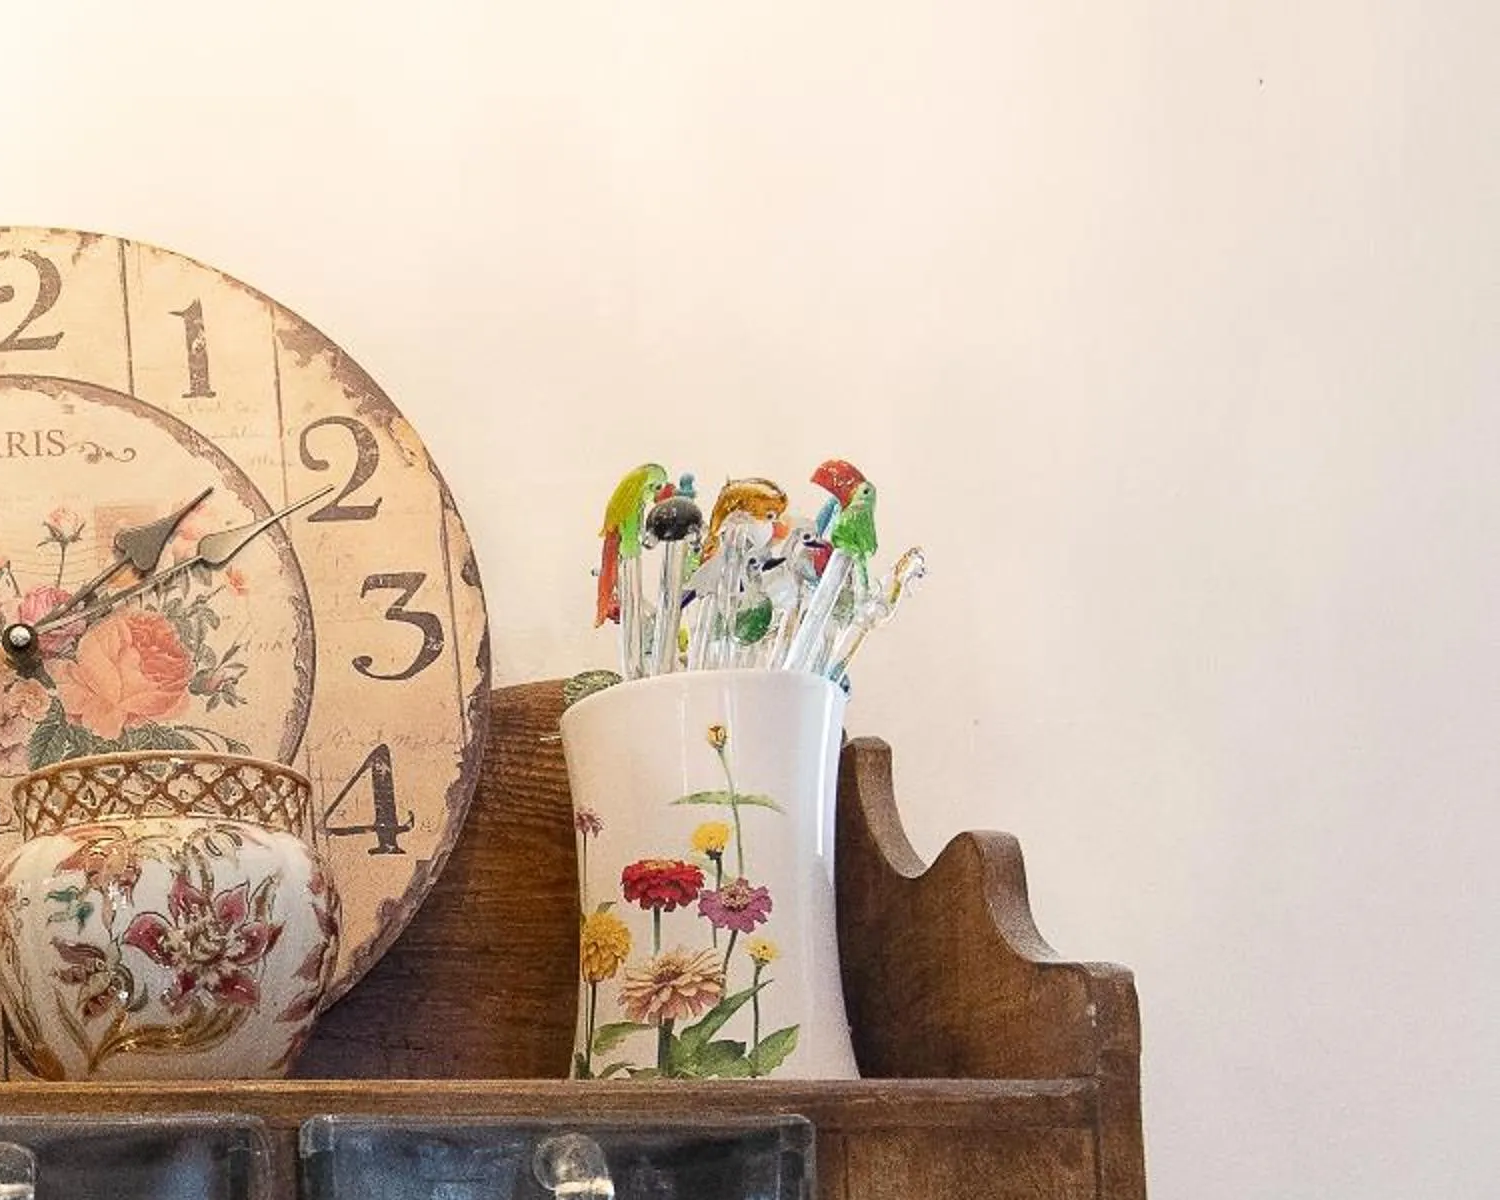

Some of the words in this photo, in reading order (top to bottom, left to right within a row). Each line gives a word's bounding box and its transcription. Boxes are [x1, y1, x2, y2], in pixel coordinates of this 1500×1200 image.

[169, 299, 216, 399] 1
[299, 416, 383, 522] 2
[352, 571, 445, 680] 3
[321, 743, 415, 855] 4
